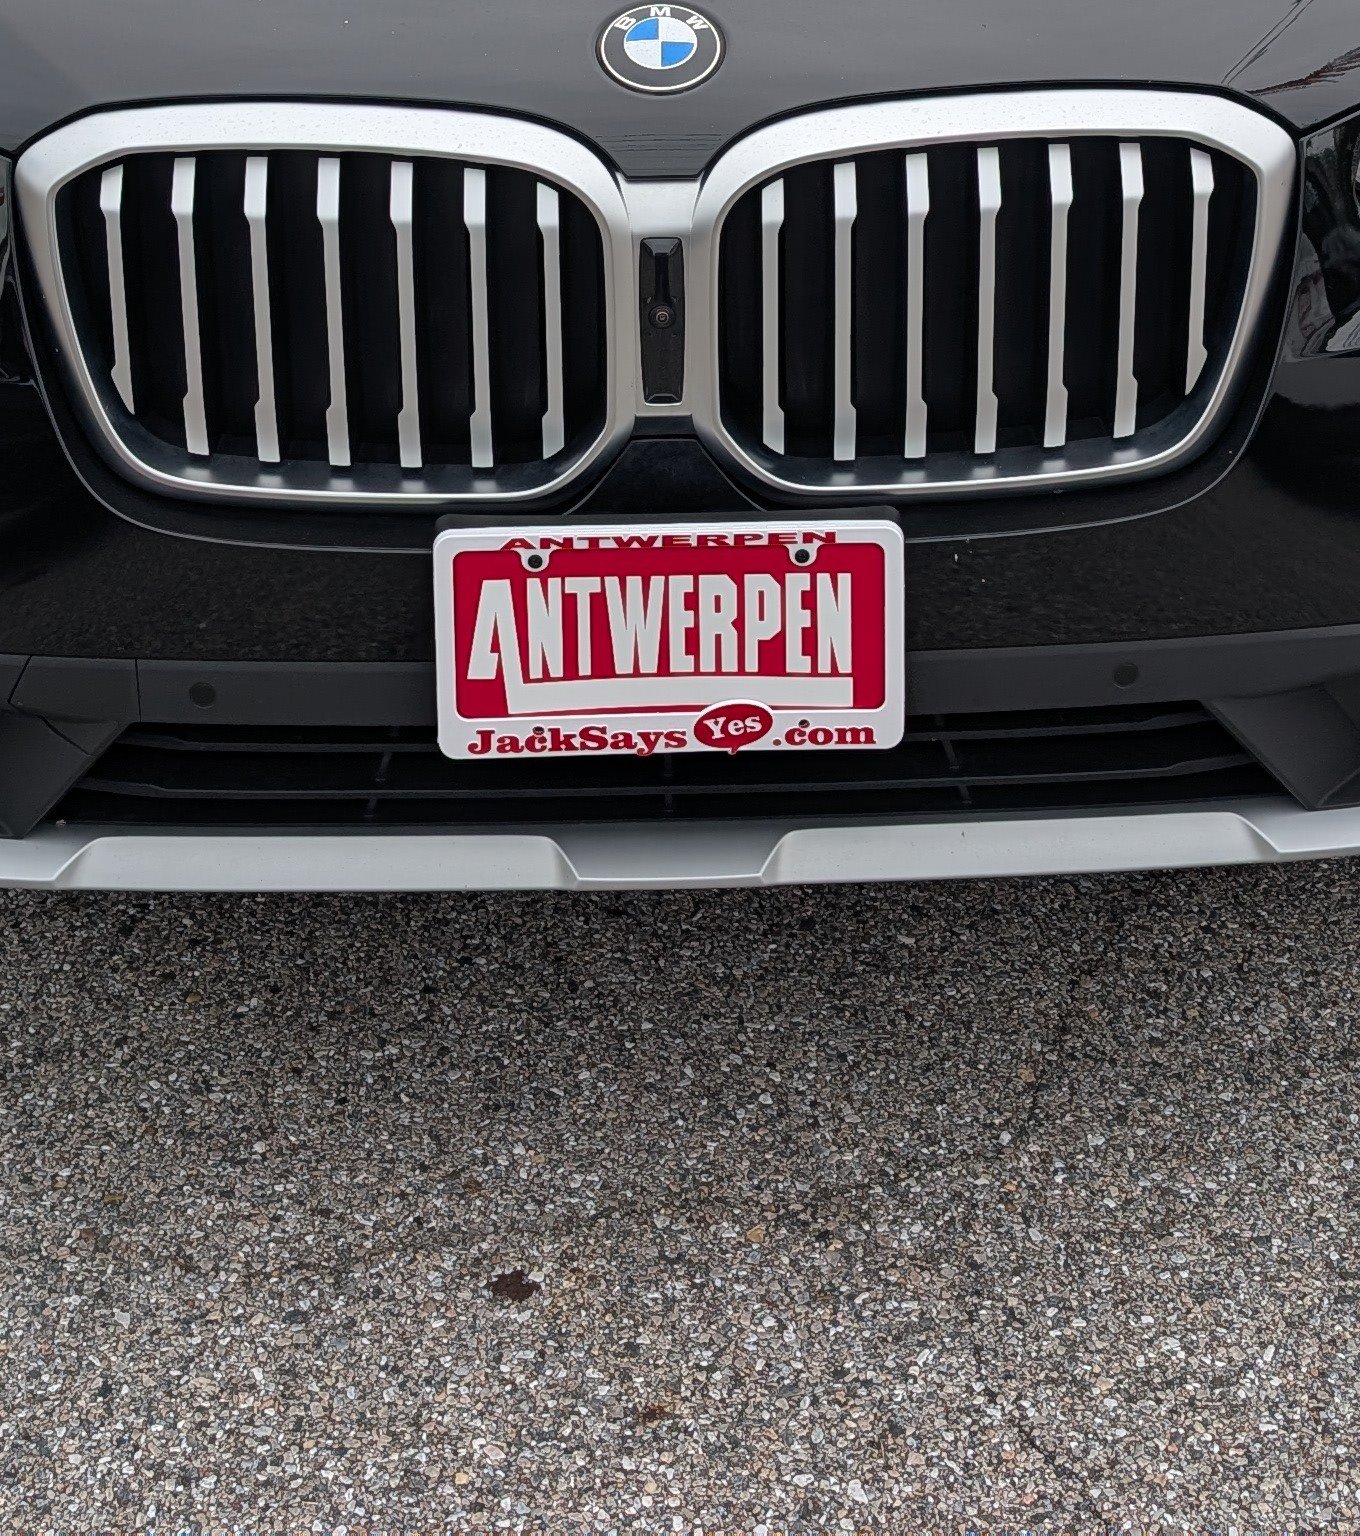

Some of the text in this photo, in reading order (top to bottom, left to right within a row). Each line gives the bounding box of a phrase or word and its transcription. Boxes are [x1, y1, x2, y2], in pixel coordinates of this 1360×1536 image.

[614, 5, 709, 31] BMW
[500, 531, 837, 550] ANTWERPEN
[466, 571, 854, 686] ANTWERPEN
[467, 724, 689, 757] JackSays
